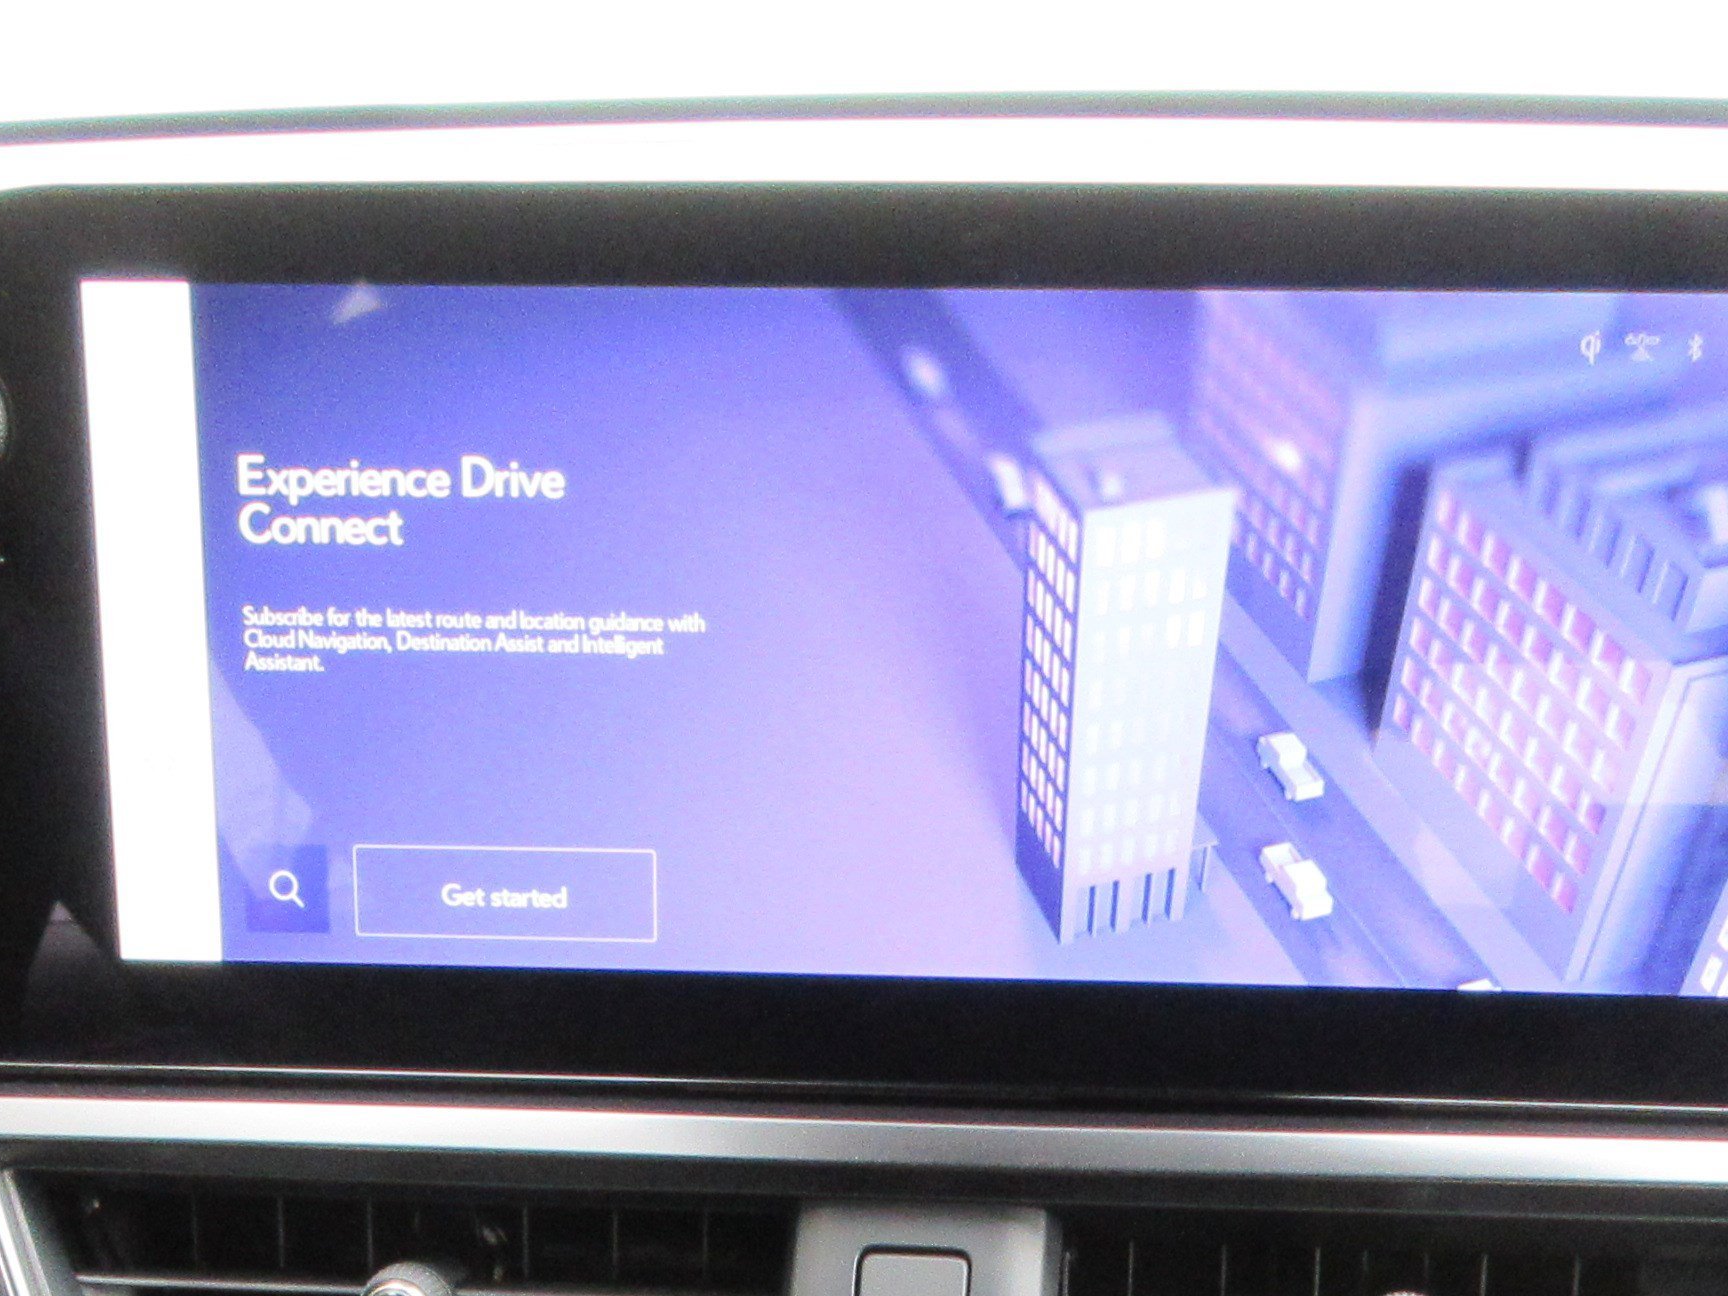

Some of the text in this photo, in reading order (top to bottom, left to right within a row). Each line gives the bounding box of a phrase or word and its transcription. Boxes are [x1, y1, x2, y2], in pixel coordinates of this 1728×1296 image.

[237, 454, 567, 506] Experience Drive
[238, 502, 404, 546] Connect
[242, 604, 706, 636] Subscribe for the latest route and location guidance with
[244, 628, 664, 660] Cloud Navigation, Destination Assist and Intelligent
[244, 650, 325, 672] Assistant.
[441, 882, 569, 909] Get started
